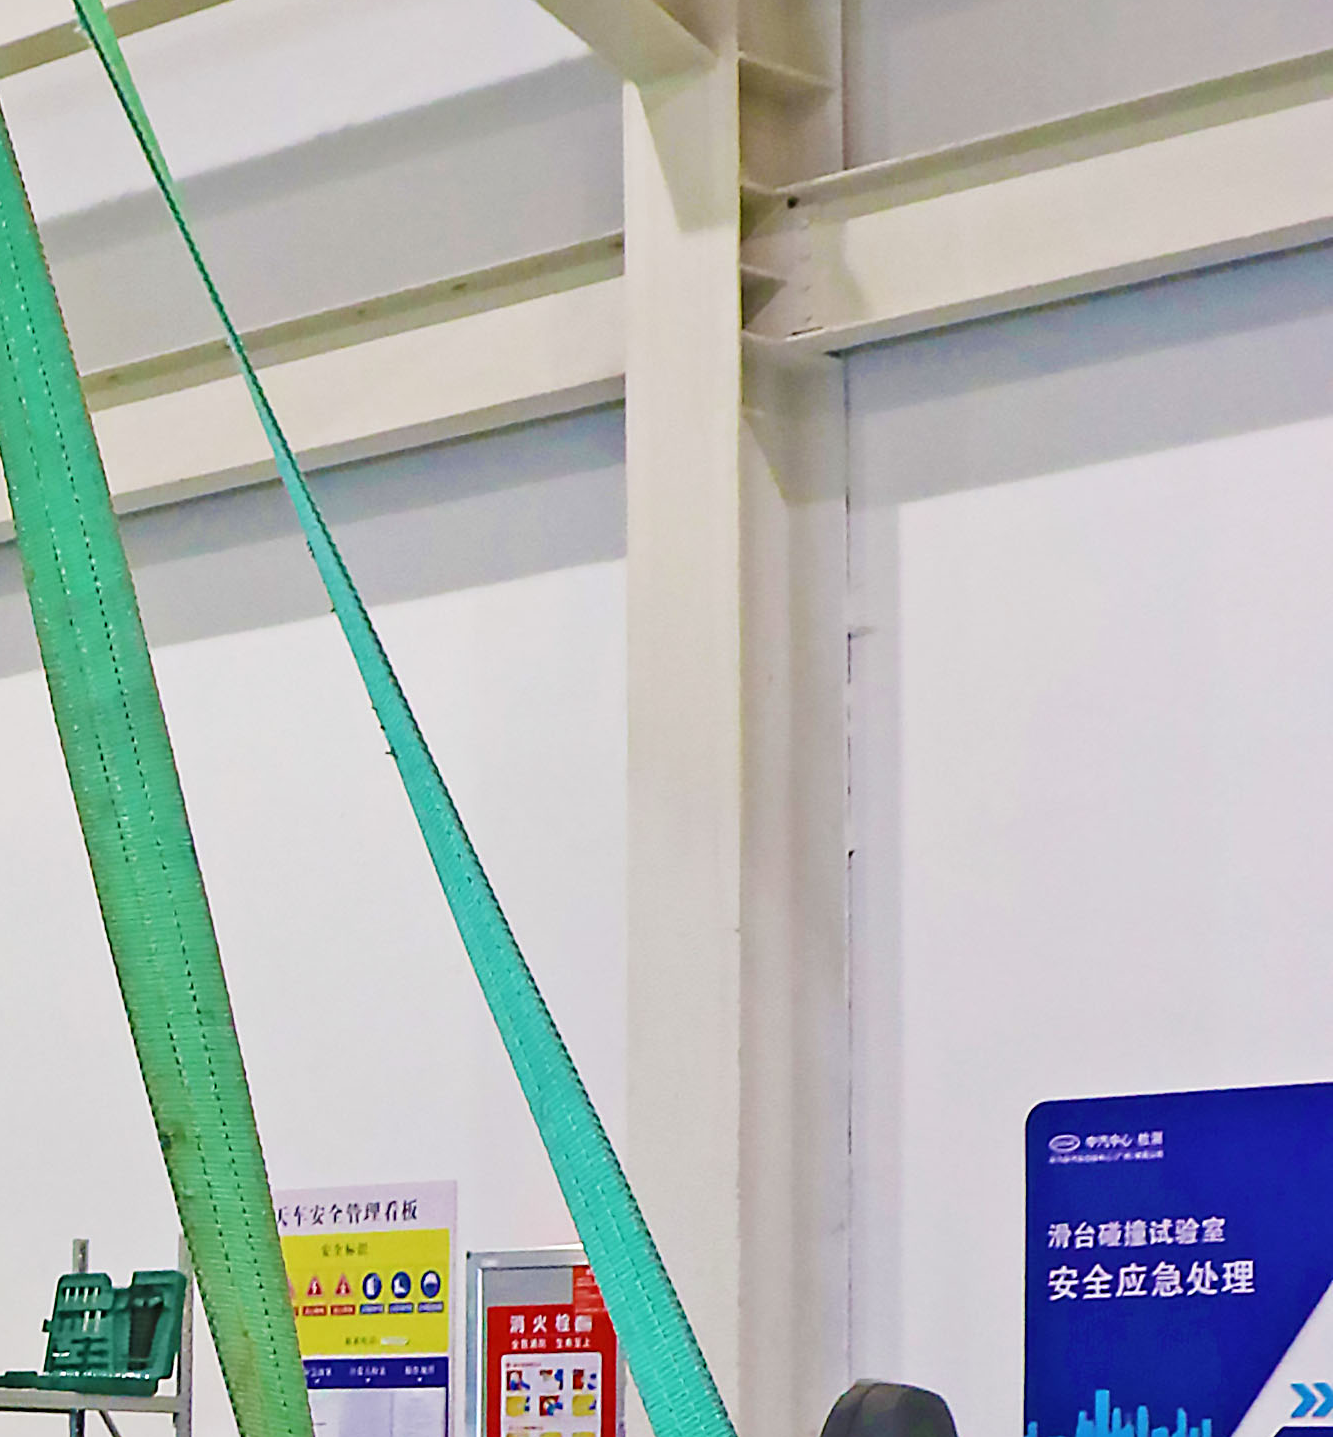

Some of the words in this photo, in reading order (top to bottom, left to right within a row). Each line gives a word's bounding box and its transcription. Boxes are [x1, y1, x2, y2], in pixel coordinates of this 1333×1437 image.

[1047, 1216, 1226, 1249] 滑台碰撞试验室
[1048, 1259, 1255, 1301] 安全应急处理
